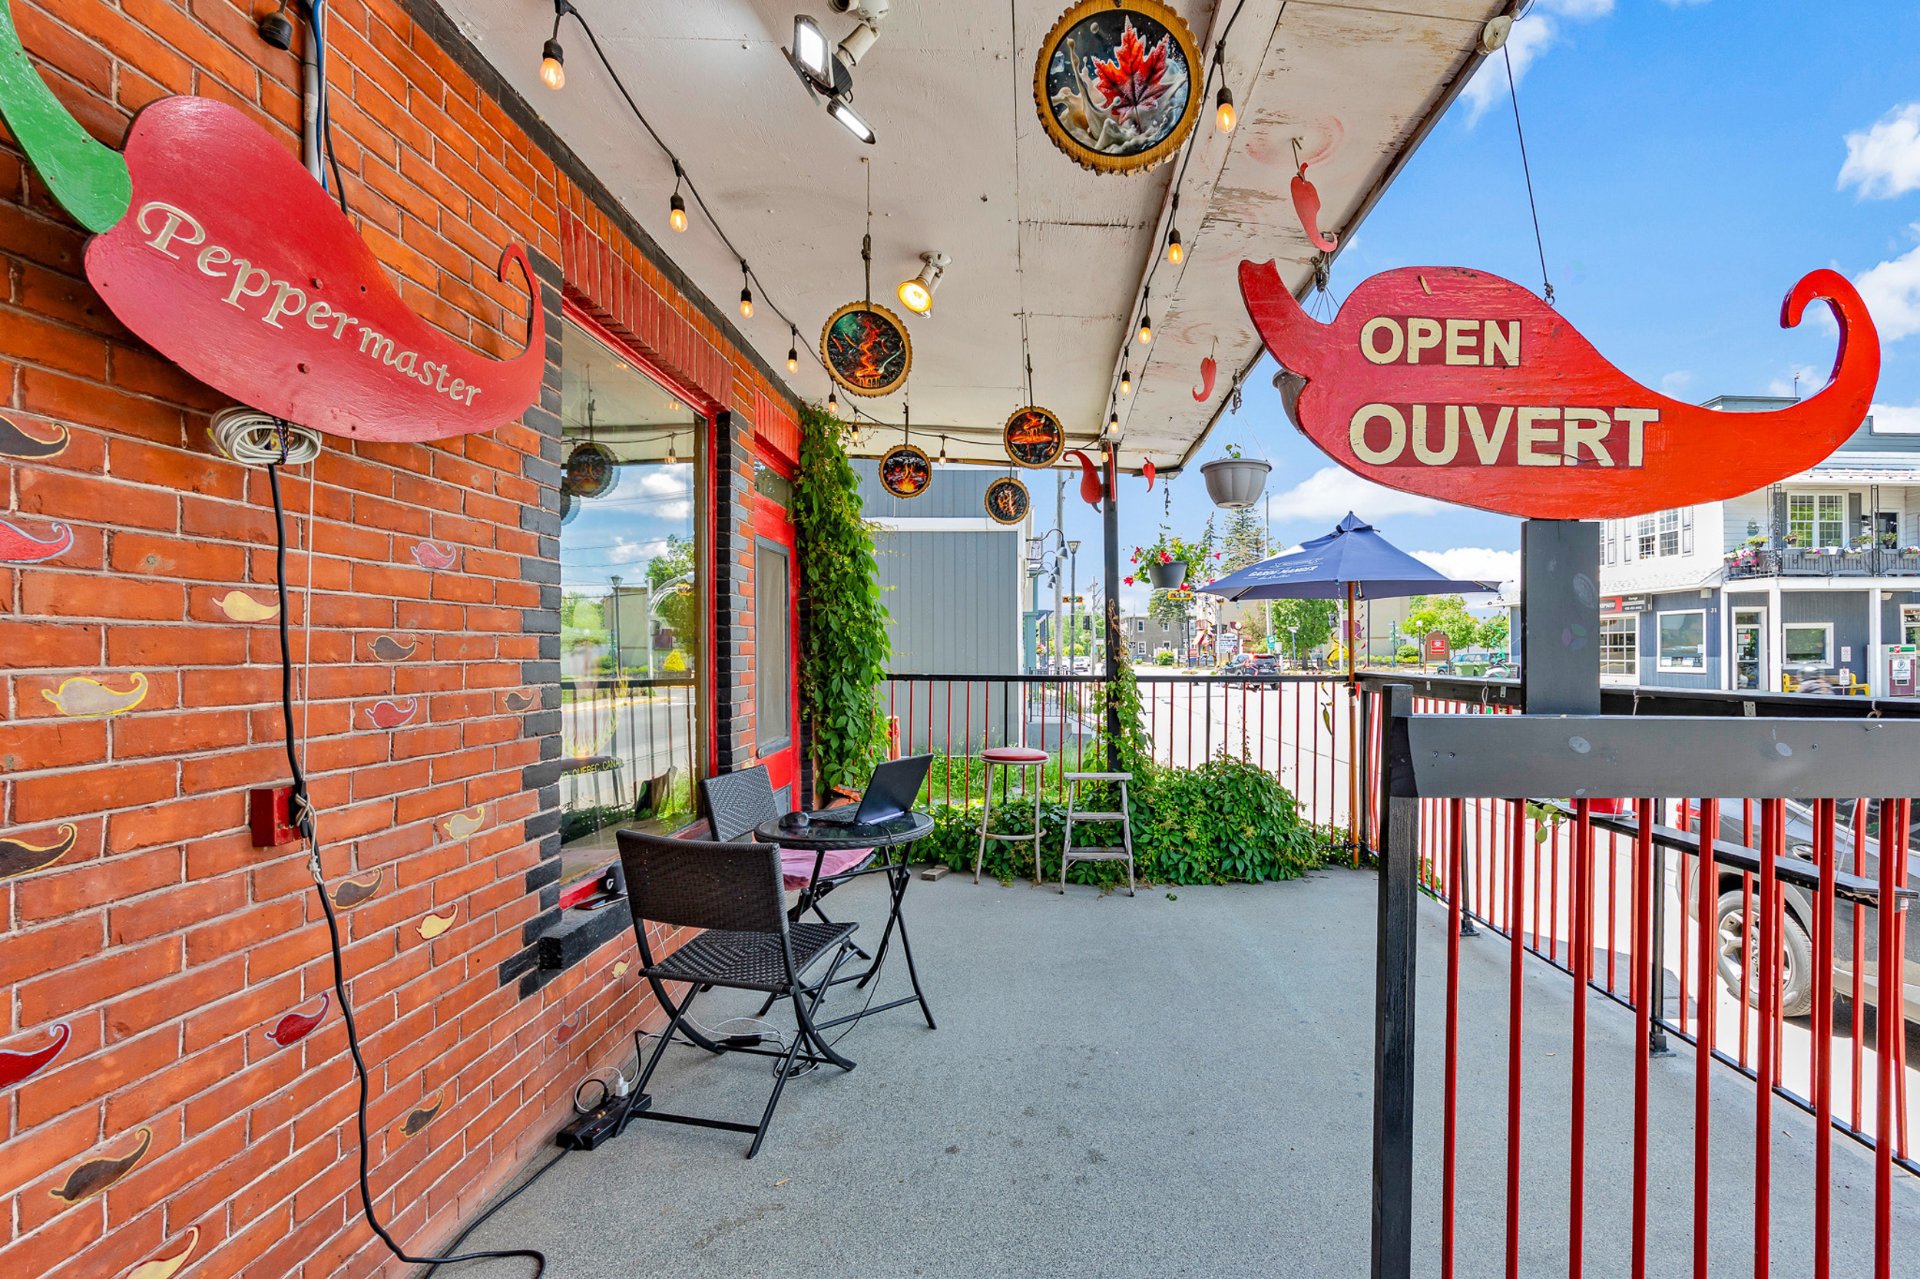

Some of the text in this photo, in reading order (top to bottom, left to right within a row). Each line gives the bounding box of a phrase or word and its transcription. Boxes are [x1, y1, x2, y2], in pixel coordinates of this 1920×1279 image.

[136, 200, 484, 408] Peppermaster
[1359, 317, 1522, 367] OPEN
[1349, 403, 1660, 468] OUVERT
[602, 759, 624, 770] CANA
